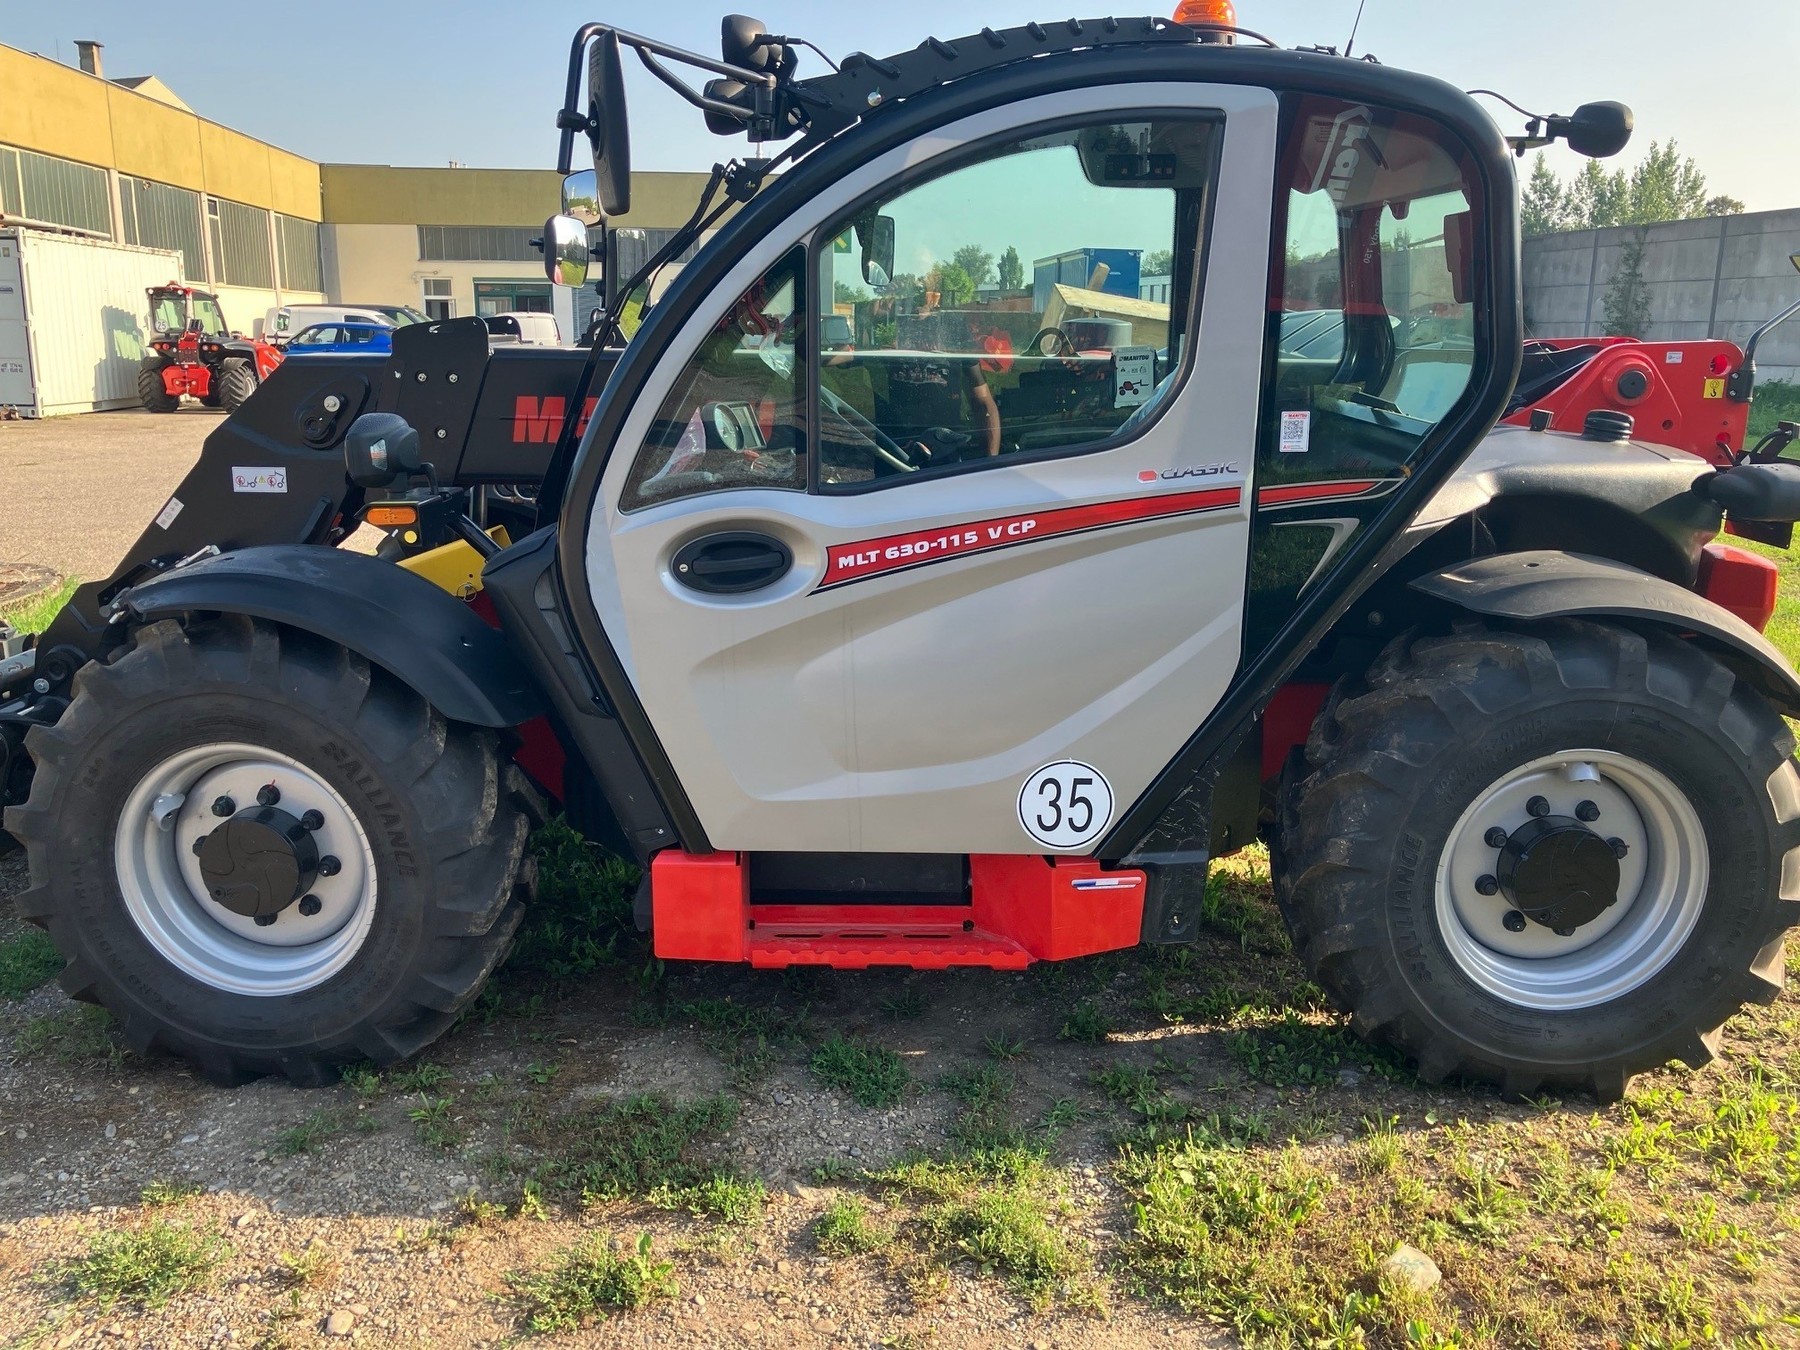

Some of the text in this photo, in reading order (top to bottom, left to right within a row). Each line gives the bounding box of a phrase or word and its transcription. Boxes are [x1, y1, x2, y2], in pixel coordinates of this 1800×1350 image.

[157, 321, 167, 330] 25
[1161, 461, 1239, 480] CLASSIC
[838, 519, 1037, 569] MLT 630-115 V CP
[338, 759, 418, 879] ALLIANCE
[1037, 777, 1093, 833] 35
[1393, 833, 1428, 964] ALLIANCE
